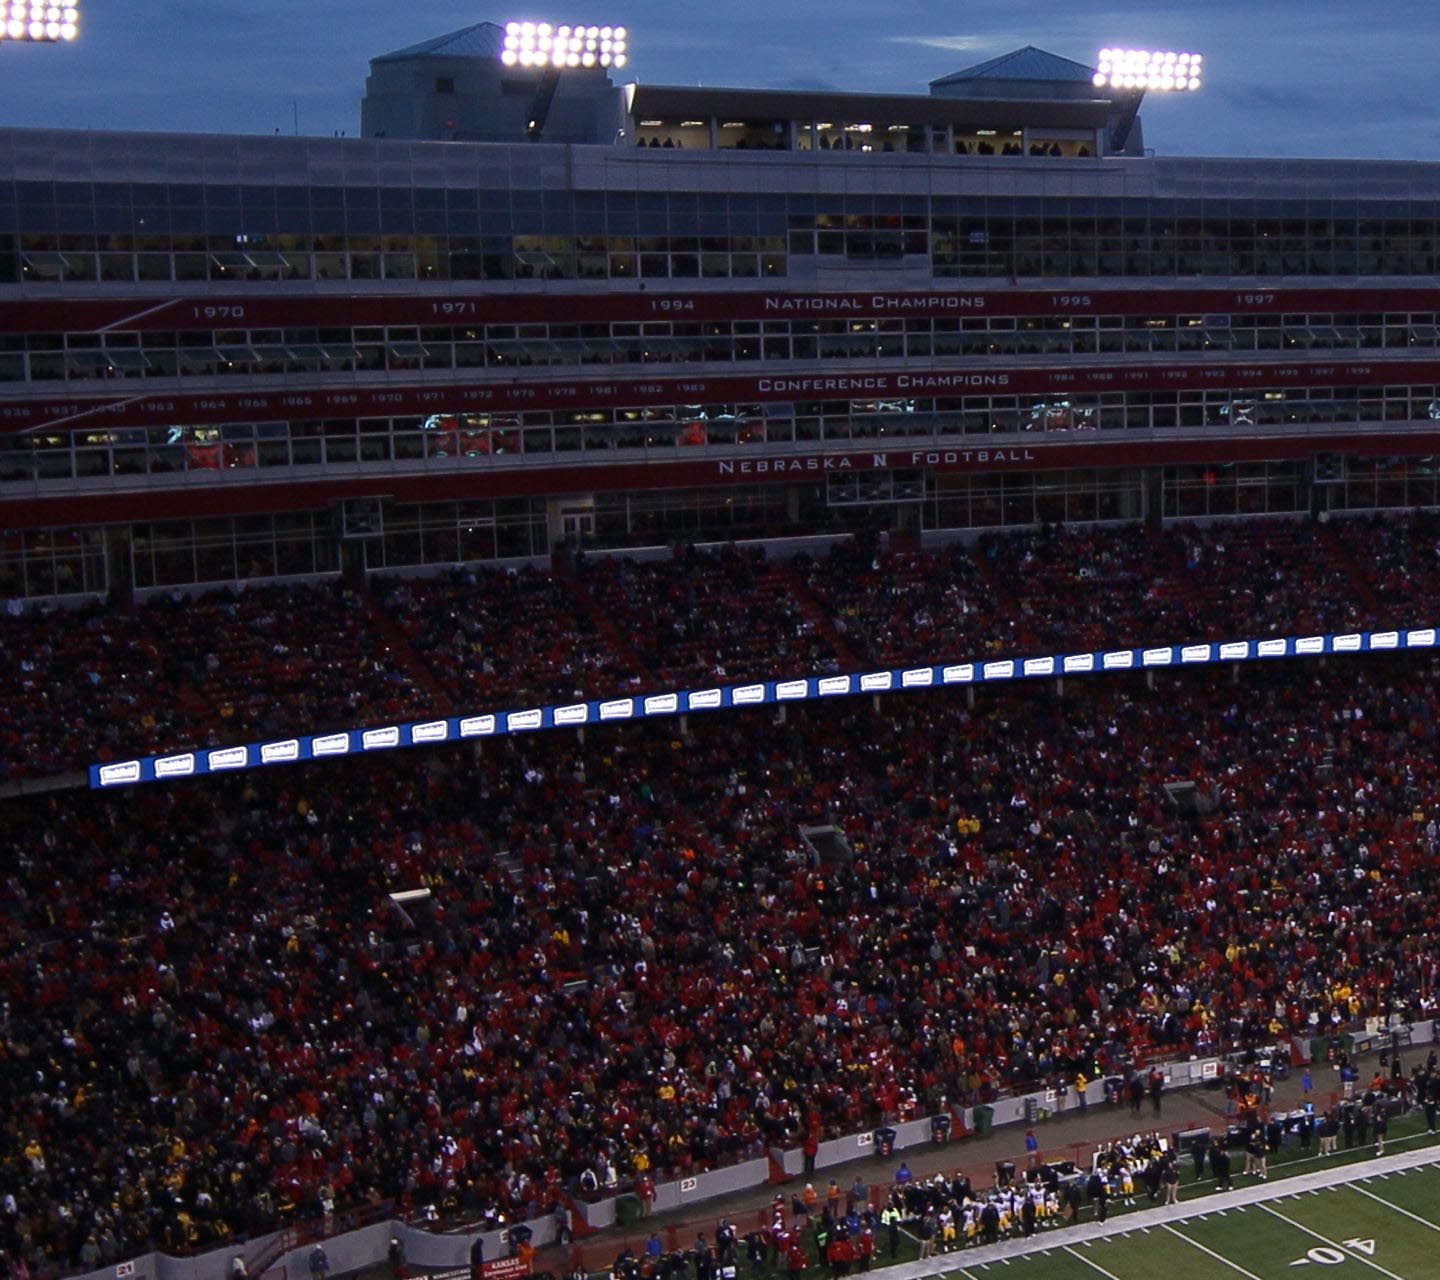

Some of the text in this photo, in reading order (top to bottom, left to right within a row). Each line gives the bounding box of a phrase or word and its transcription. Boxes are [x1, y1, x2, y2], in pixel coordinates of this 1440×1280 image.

[650, 298, 696, 311] 1994
[765, 295, 986, 310] NATIONAL CHAMPIONS
[1052, 295, 1092, 307] 1995
[1236, 293, 1275, 305] 1997
[193, 306, 245, 319] 1970
[431, 302, 477, 315] 1971
[758, 374, 1010, 393] CONFERENCE CHAMPIONS
[192, 399, 227, 410] 1964
[416, 391, 446, 402] 1971
[718, 457, 853, 474] NEBRASKA
[912, 449, 1035, 465] FOOTBALL
[1306, 1236, 1378, 1266] 40
